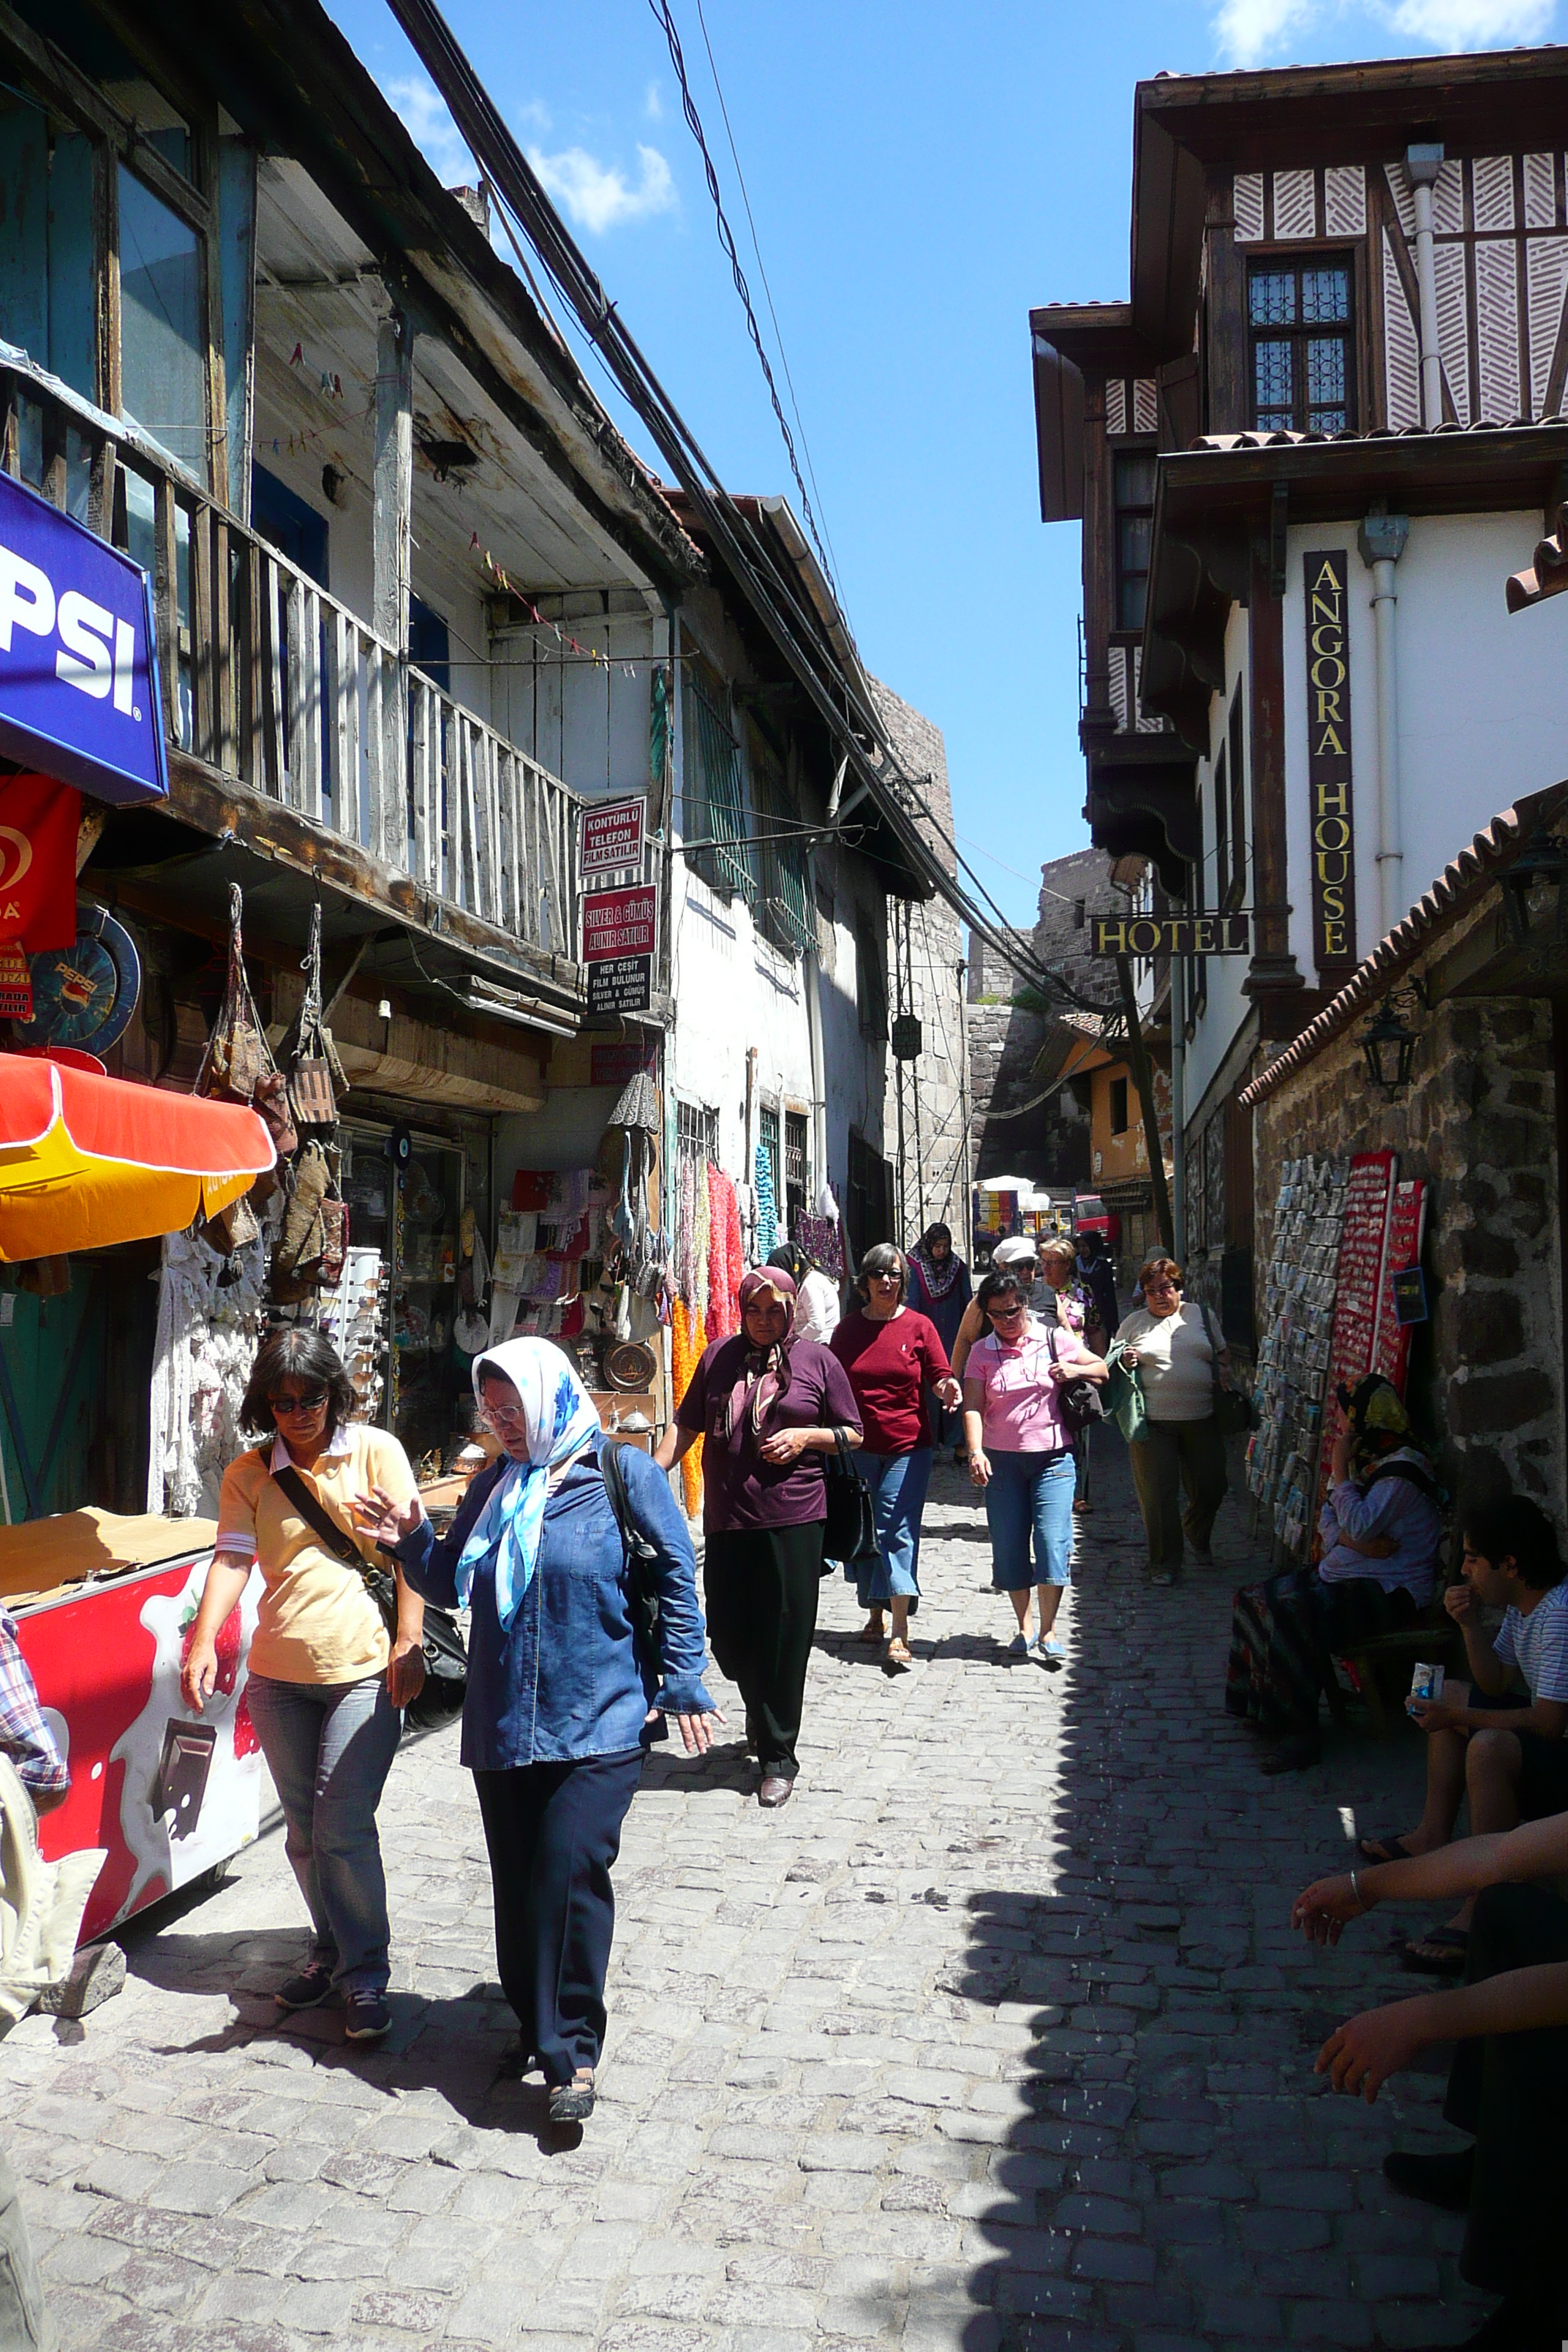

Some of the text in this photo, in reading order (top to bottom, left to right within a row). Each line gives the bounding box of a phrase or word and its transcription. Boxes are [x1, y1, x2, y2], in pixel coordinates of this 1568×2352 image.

[1311, 559, 1351, 954] ANGORA HOUSE
[587, 808, 638, 832] KONTÜRLÜ
[589, 829, 631, 848] TELEFON
[603, 843, 638, 859] SATILIR
[0, 902, 20, 919] A
[615, 905, 622, 924] &
[623, 898, 654, 923] GÜMÜŞ
[589, 925, 649, 951] ALINIR SATILIR
[1097, 919, 1243, 954] HOTEL
[600, 959, 638, 975] HER ÇEŞİT
[55, 961, 98, 995] PEPSI
[611, 973, 645, 986] BULUNUR
[615, 989, 619, 997] &
[619, 998, 641, 1008] SATILIR
